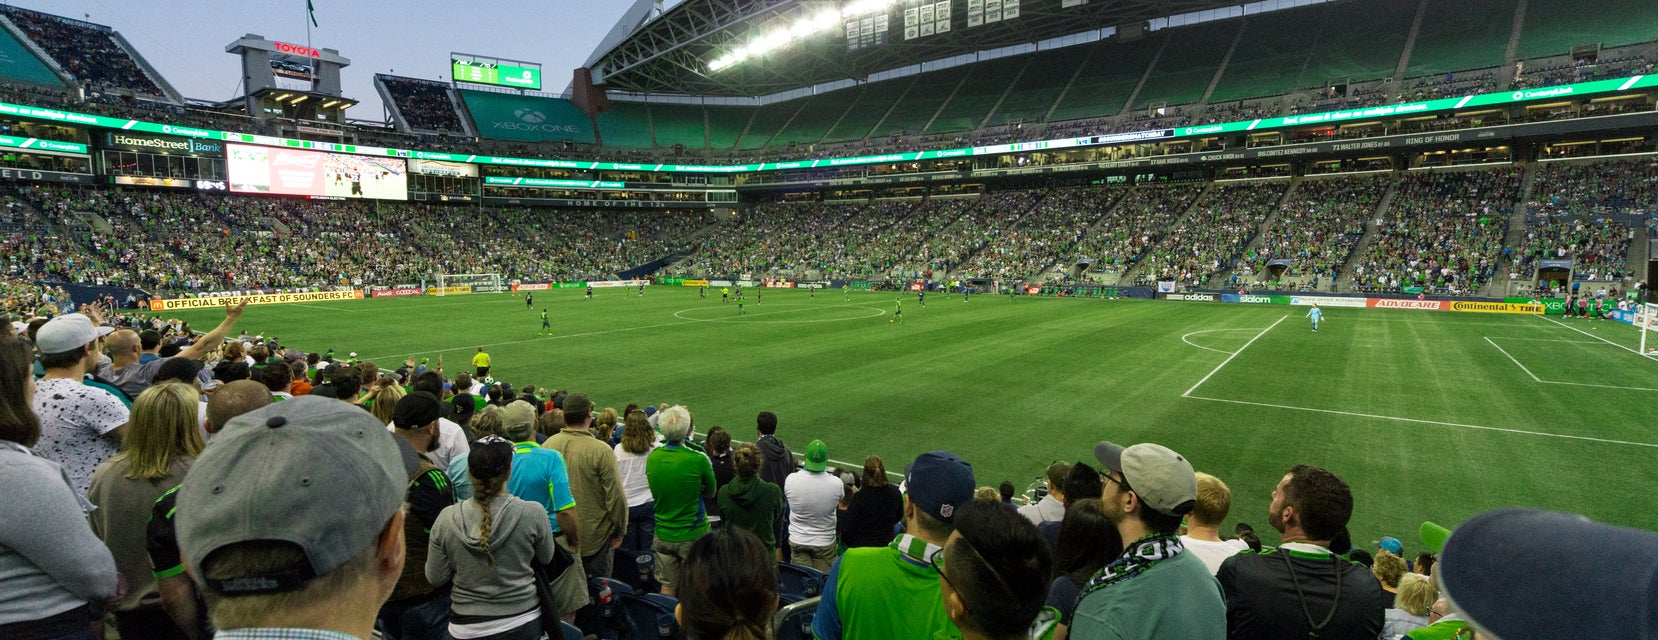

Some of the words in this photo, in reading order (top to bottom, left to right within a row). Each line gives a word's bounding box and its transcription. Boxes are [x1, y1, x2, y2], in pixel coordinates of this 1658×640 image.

[273, 41, 320, 58] TOYOTA
[491, 121, 539, 132] XBOX
[541, 124, 580, 134] ONE
[1435, 134, 1460, 142] HONOR
[195, 143, 221, 152] Bank
[167, 298, 217, 309] OFFICIAL
[218, 295, 277, 306] BREAKFAST
[280, 294, 291, 302] OF
[294, 292, 341, 302] SOUNDERS
[1240, 295, 1271, 304] slalom
[1376, 299, 1440, 309] ADVOCARE
[1454, 302, 1508, 311] Continental
